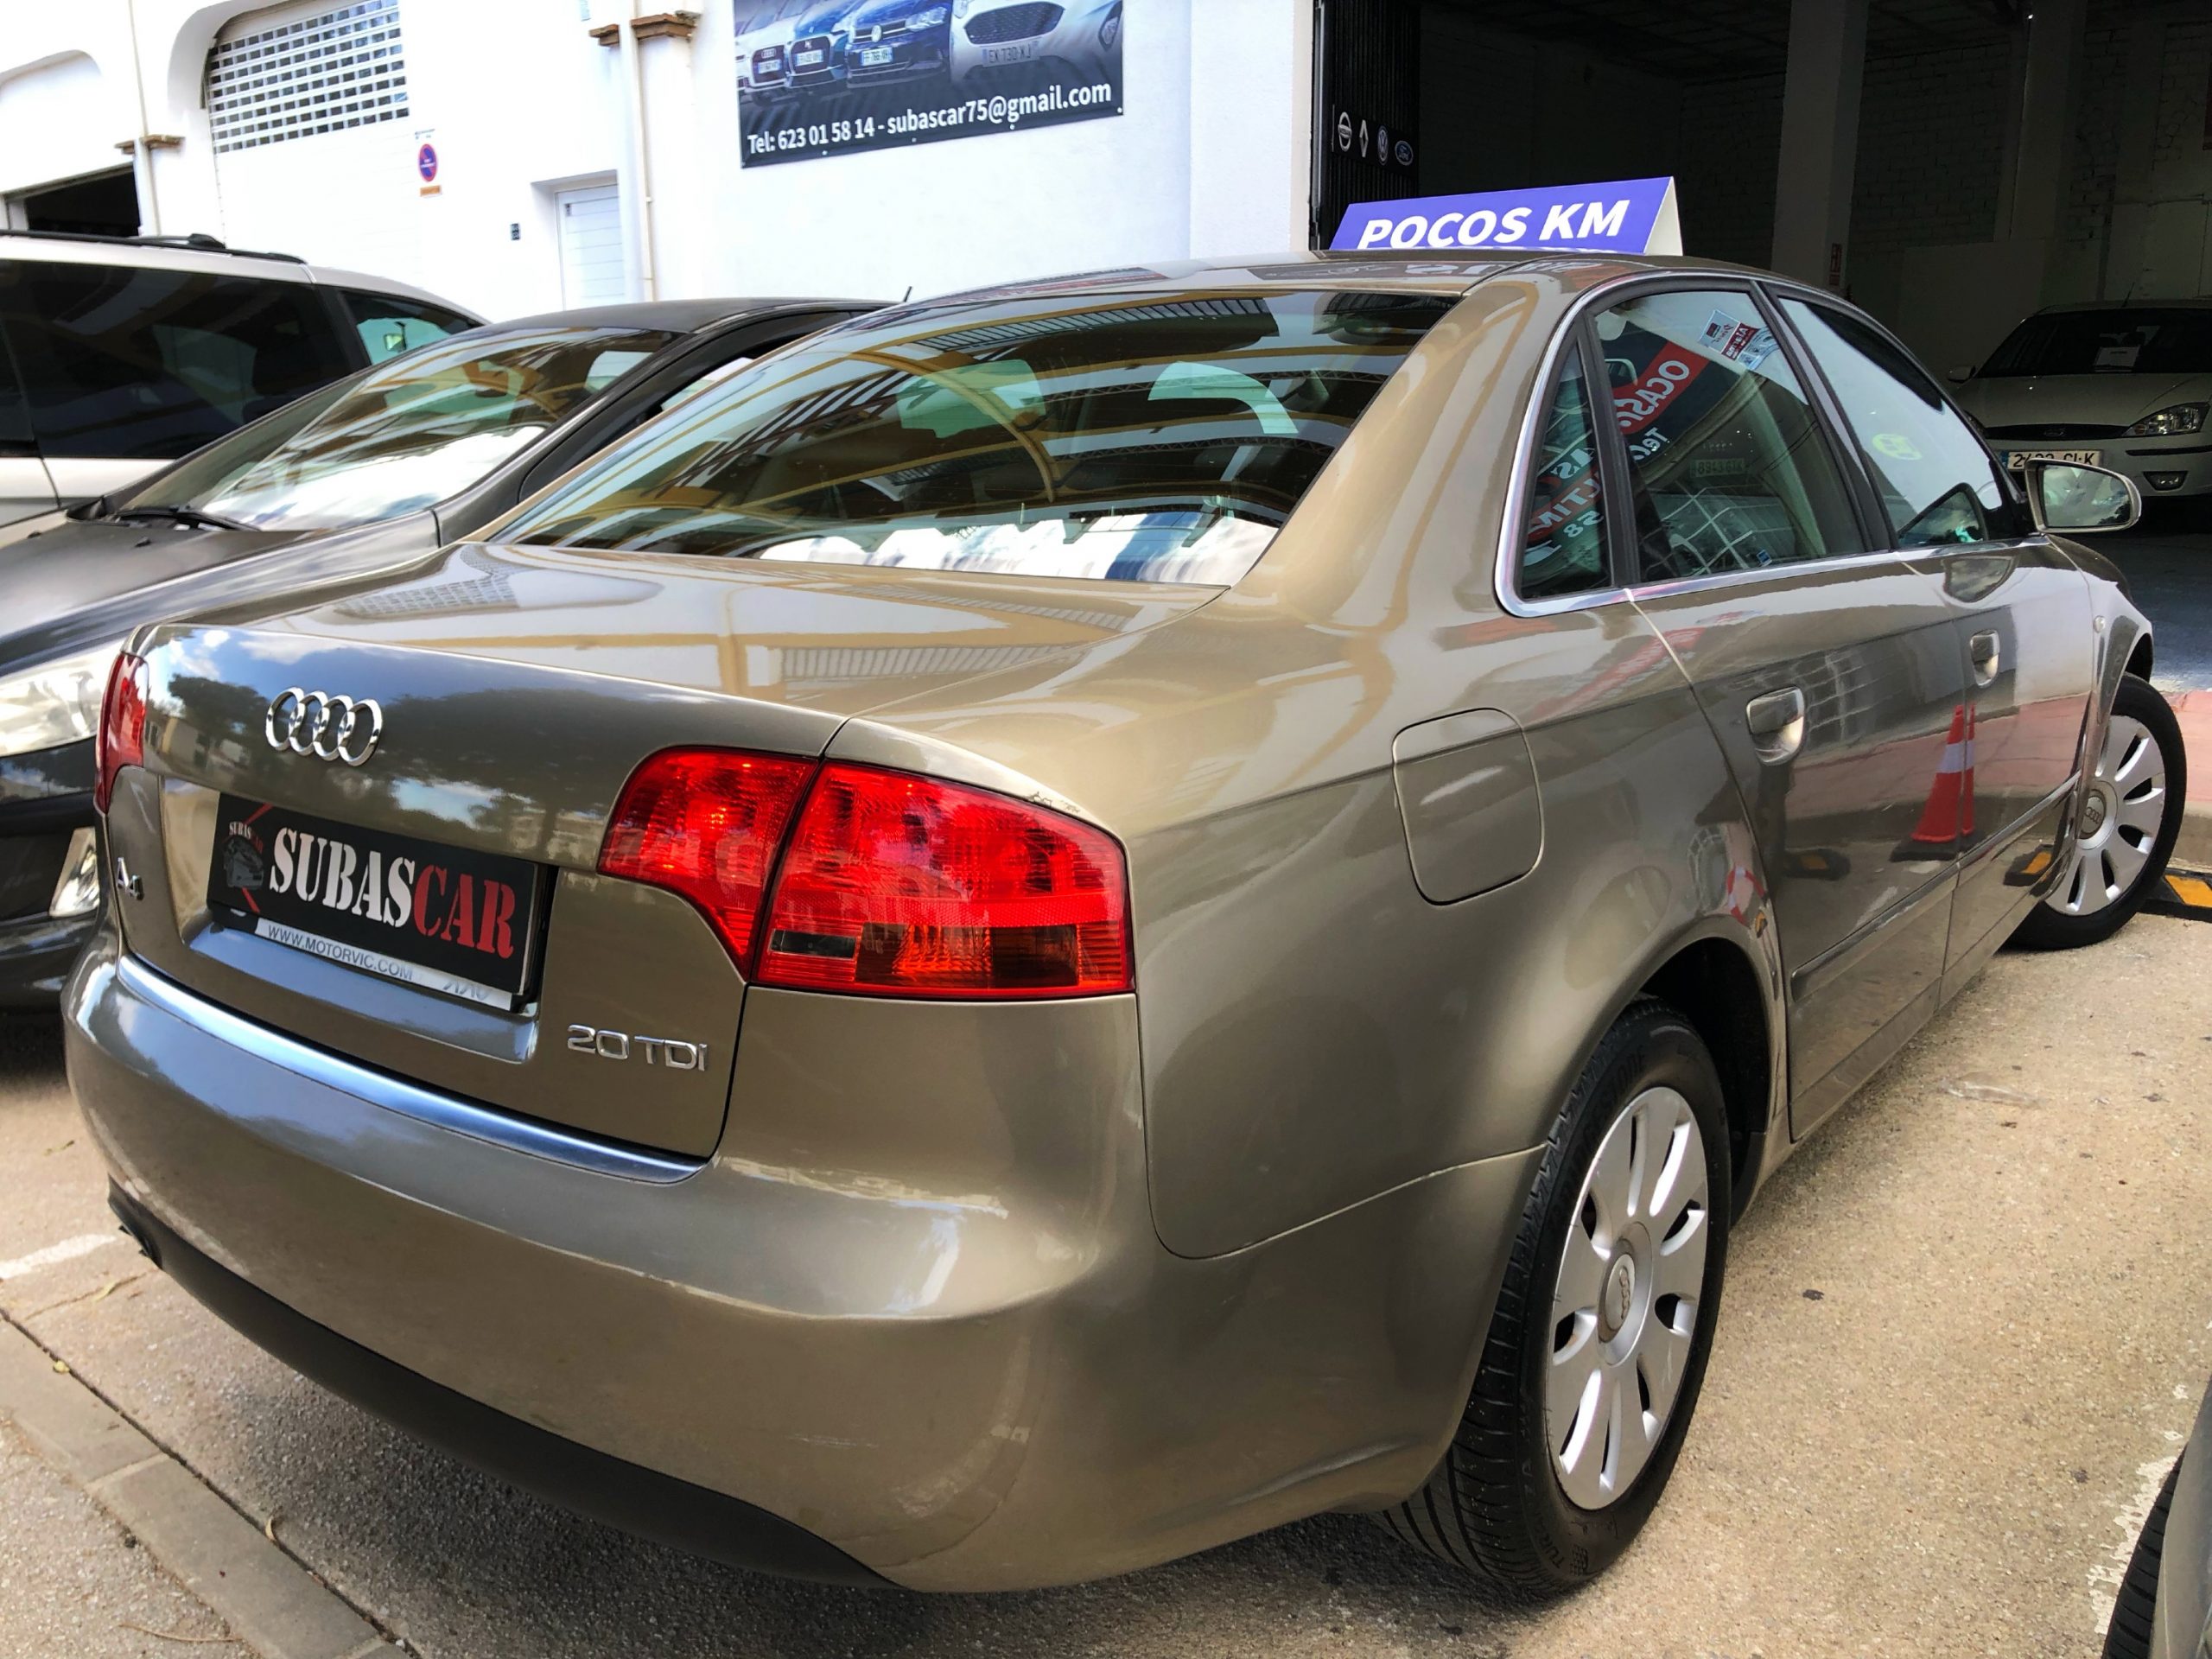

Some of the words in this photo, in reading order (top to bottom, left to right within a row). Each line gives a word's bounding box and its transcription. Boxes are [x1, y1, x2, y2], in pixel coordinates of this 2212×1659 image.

[747, 134, 776, 154] Tel:
[778, 127, 805, 149] 623
[810, 125, 829, 145] 01
[831, 122, 851, 143] 58
[855, 118, 875, 139] 14
[887, 83, 1112, 135] subascar75@gmail.com
[1357, 207, 1532, 250] POCOS
[1538, 200, 1630, 241] KM
[270, 827, 516, 959] SUBASCAR
[268, 925, 413, 980] WWW.MOTORVIC.COM
[634, 1035, 708, 1071] TDI
